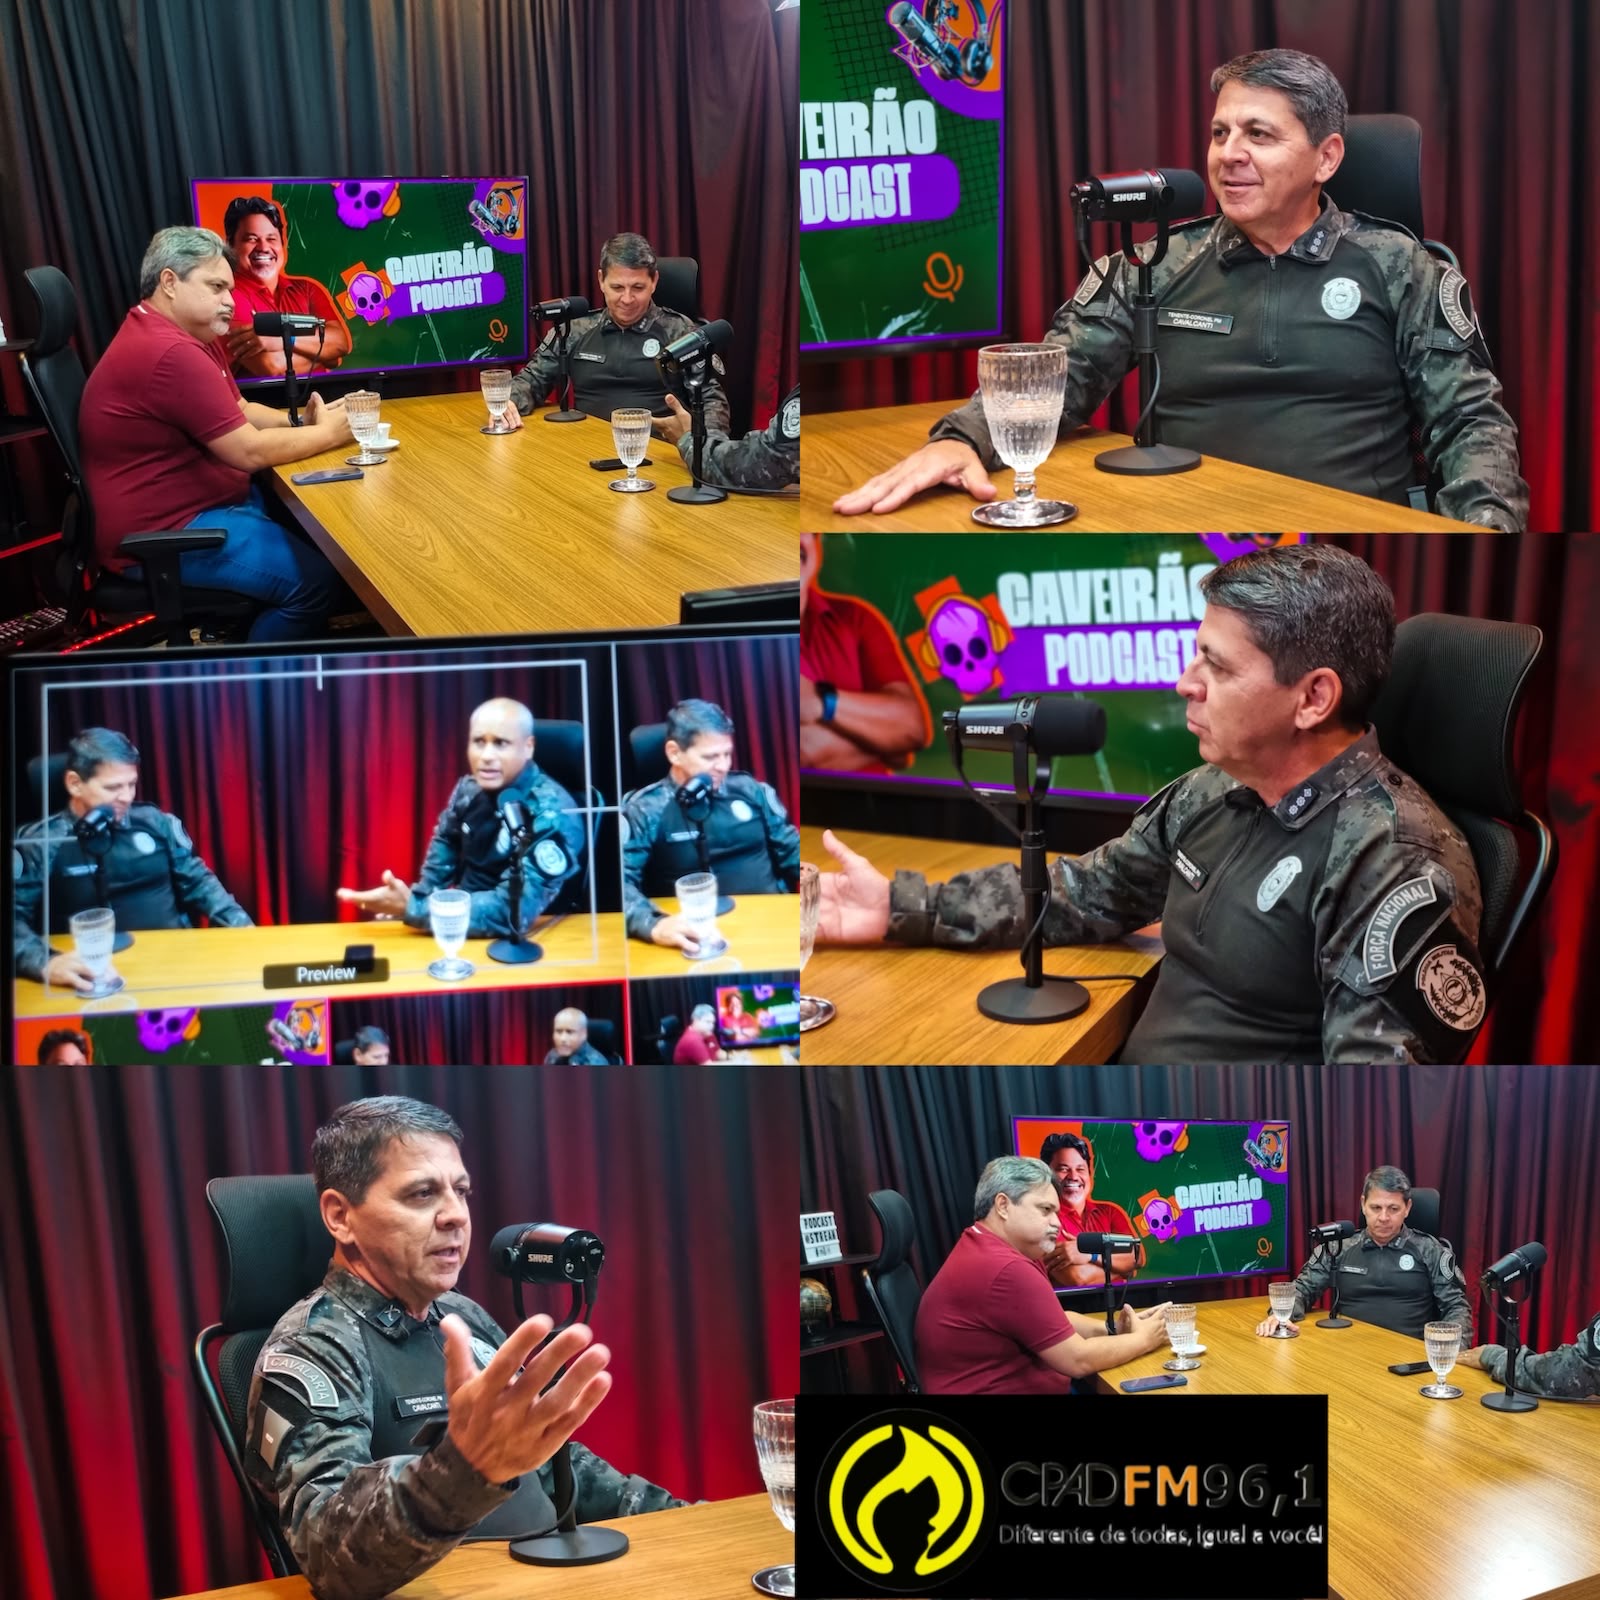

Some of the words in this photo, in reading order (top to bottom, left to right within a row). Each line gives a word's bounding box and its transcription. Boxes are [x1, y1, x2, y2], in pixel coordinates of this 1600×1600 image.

[800, 87, 937, 160] EIRÃO
[800, 163, 912, 225] DCAST
[1112, 192, 1147, 202] SHURE
[385, 241, 494, 285] CAVEIRÃO
[409, 277, 483, 313] PODCAST
[1442, 272, 1461, 302] NACIONAL
[1173, 318, 1214, 329] CAVALCANTI
[1446, 304, 1467, 332] FORÇA
[1043, 629, 1198, 686] PODCAST
[965, 725, 1005, 735] SHURE
[1375, 884, 1430, 929] NACIONAL
[1369, 930, 1388, 970] FORÇA
[297, 965, 356, 982] Preview
[1174, 1173, 1263, 1210] CAVEIRÃO
[804, 1216, 833, 1229] PODCAST
[1194, 1203, 1253, 1233] PODCAST
[527, 1253, 554, 1263] SHURE
[271, 1358, 330, 1400] CAVALARIA
